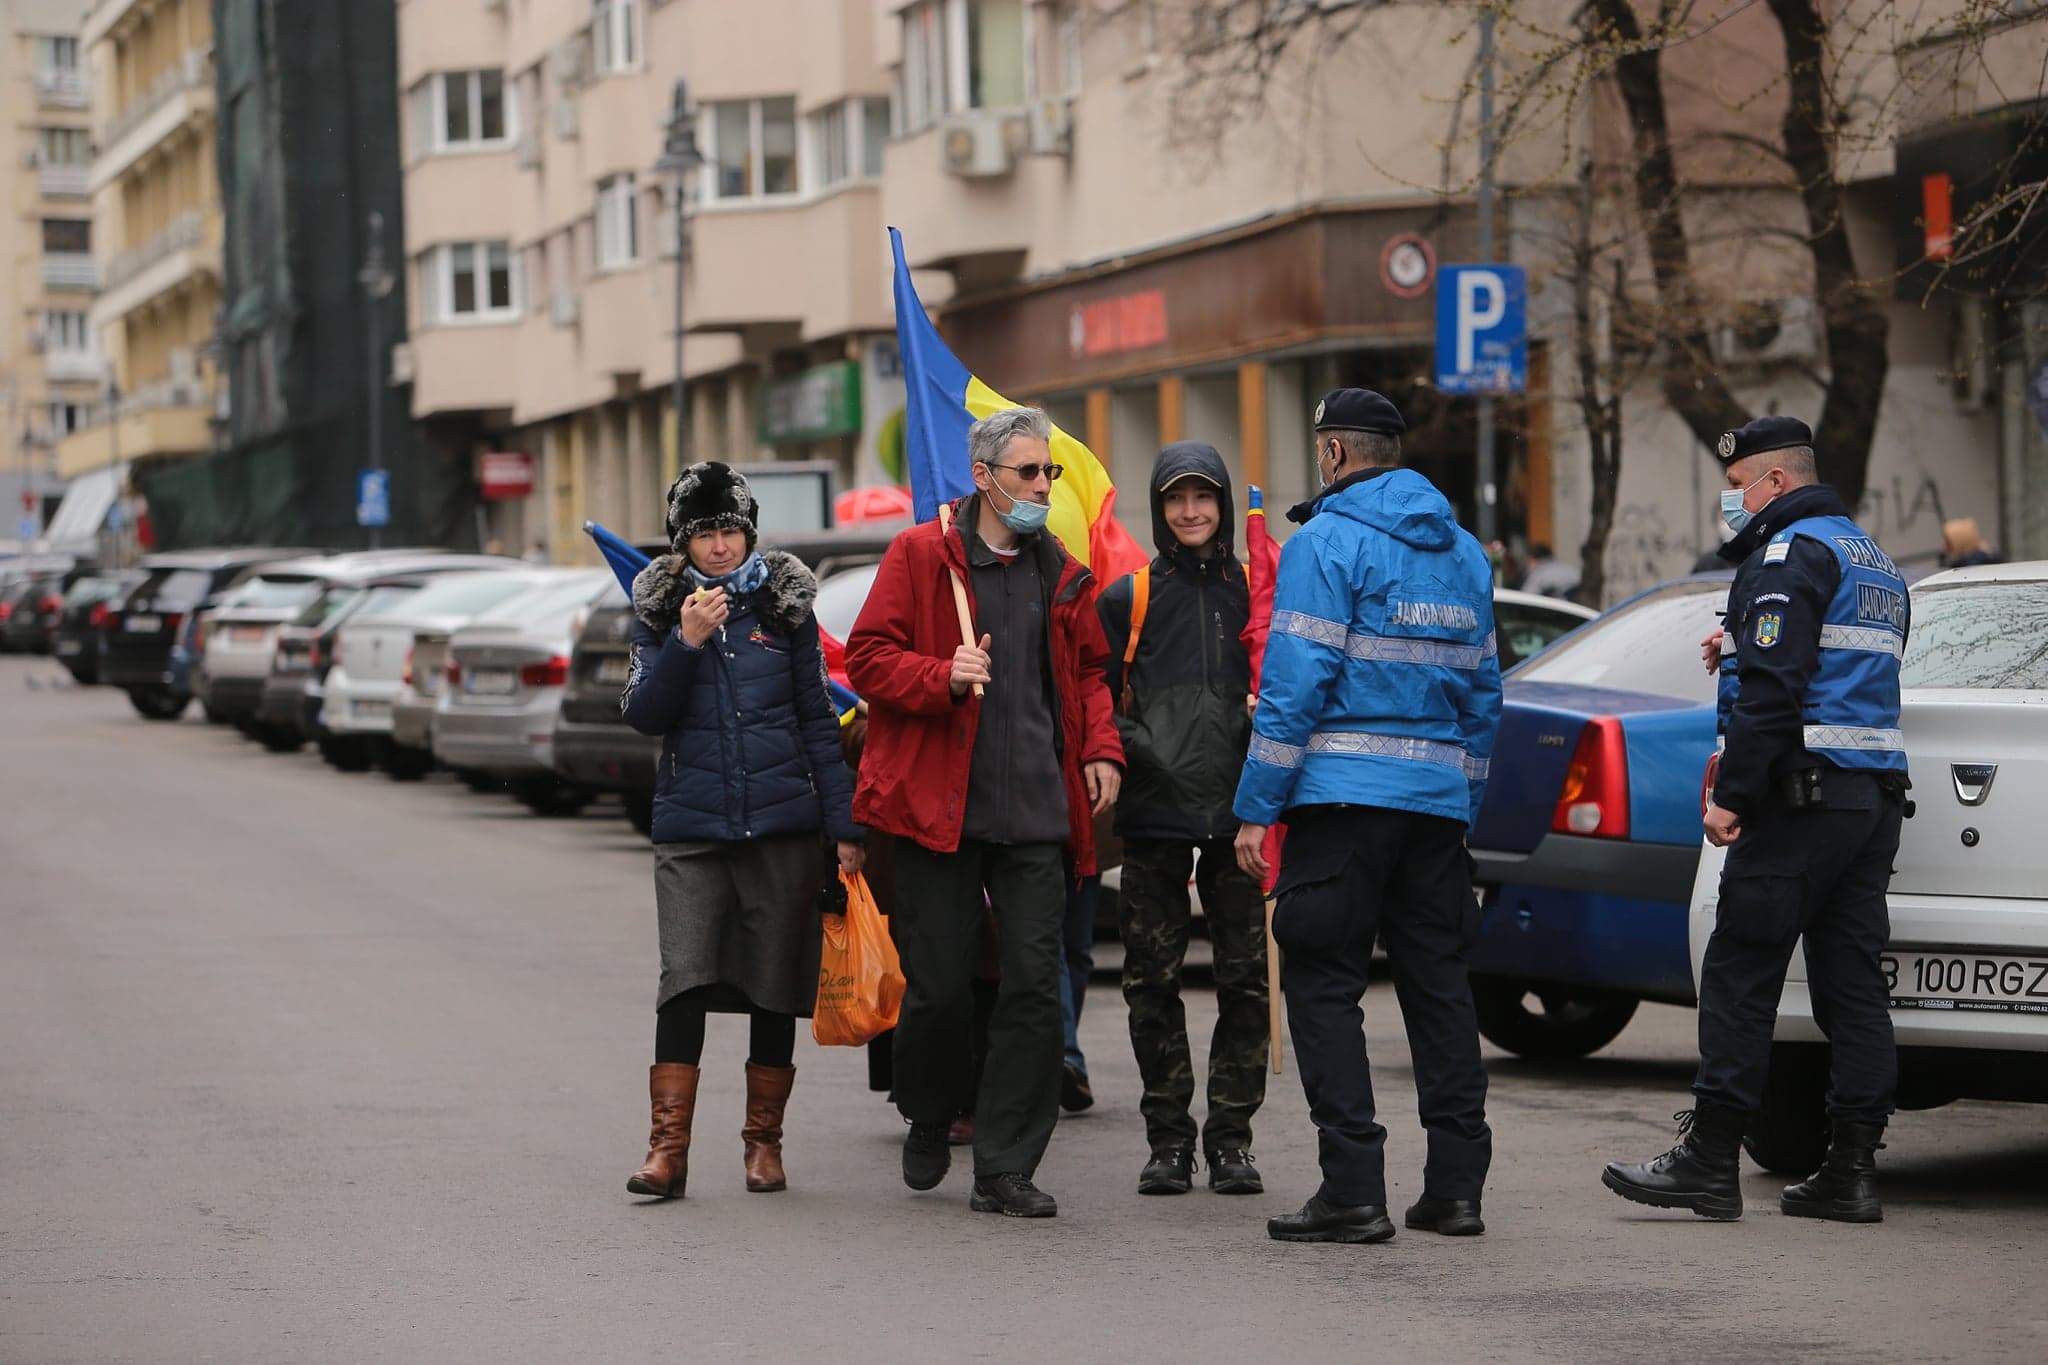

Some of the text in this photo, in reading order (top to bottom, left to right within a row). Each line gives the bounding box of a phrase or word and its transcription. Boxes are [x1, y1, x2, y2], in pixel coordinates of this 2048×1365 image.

[1457, 270, 1506, 373] P
[1392, 601, 1478, 630] JANDARMERIA
[1878, 956, 1900, 991] B
